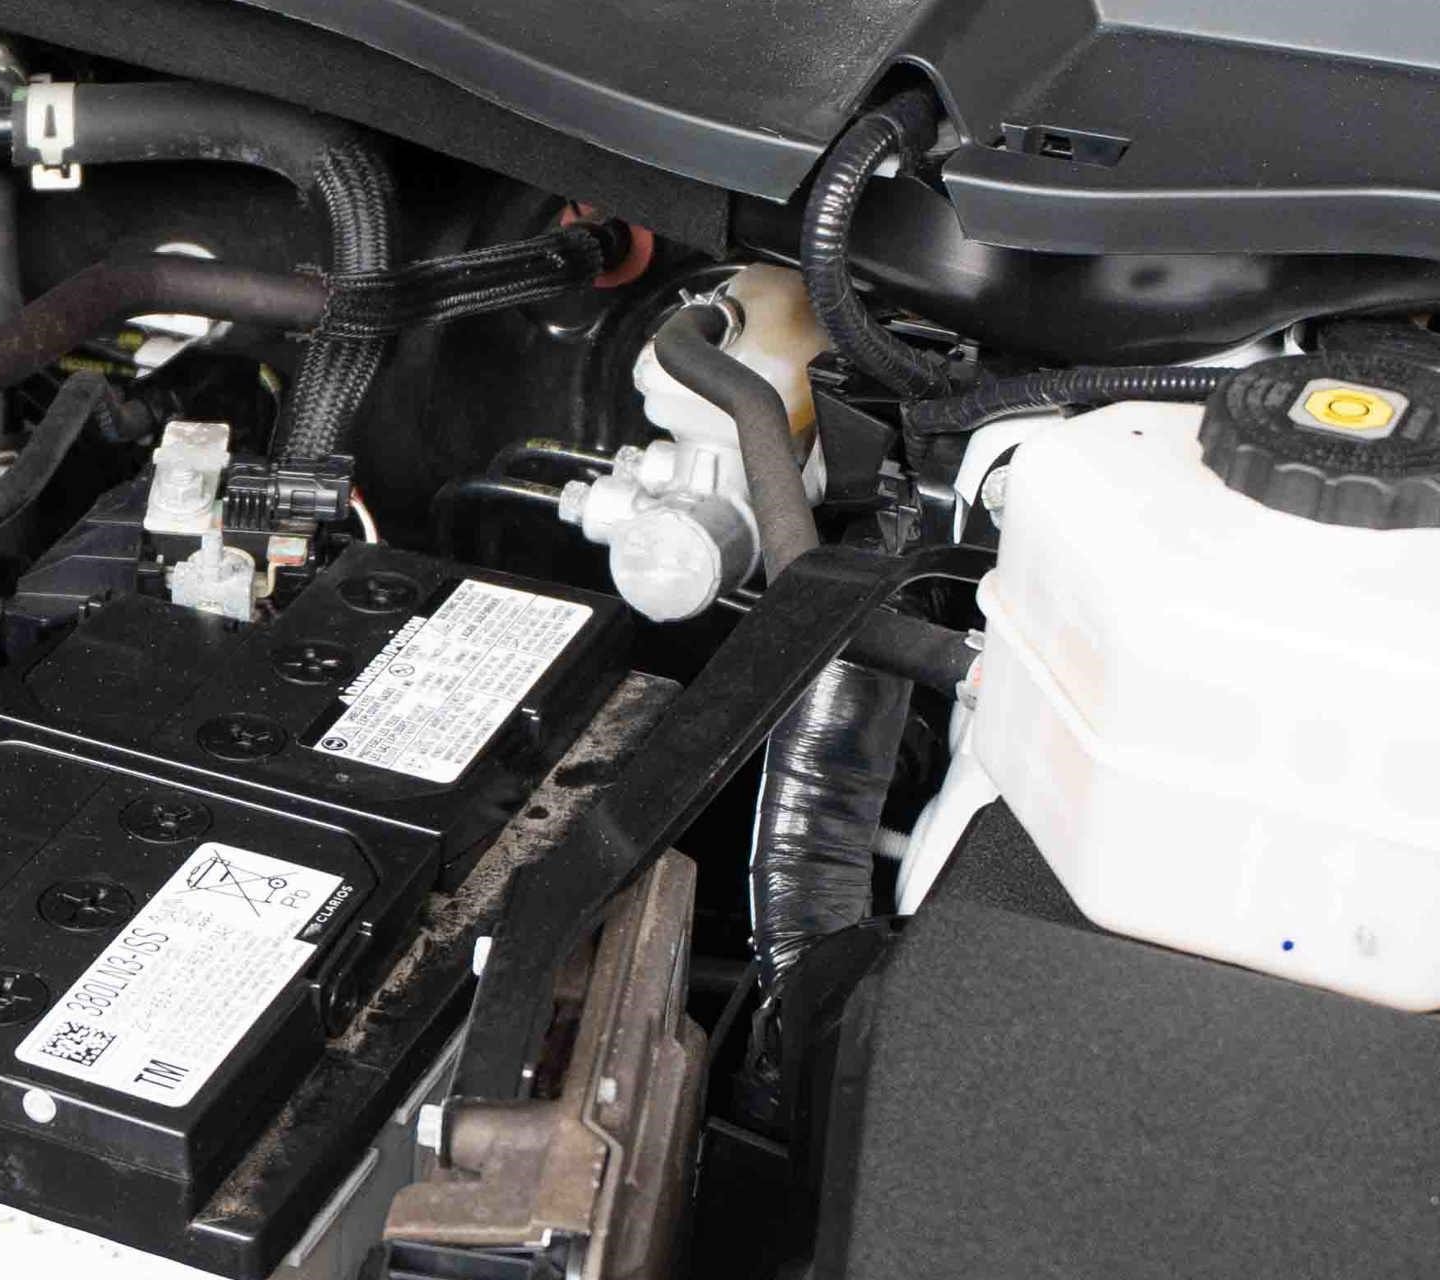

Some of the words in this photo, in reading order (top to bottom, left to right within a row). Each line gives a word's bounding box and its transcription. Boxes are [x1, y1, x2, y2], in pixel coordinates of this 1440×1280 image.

[279, 888, 311, 910] Pb
[315, 885, 353, 923] CLARIOS
[65, 926, 170, 1018] 380LN3-ISS
[133, 1058, 190, 1090] TM
